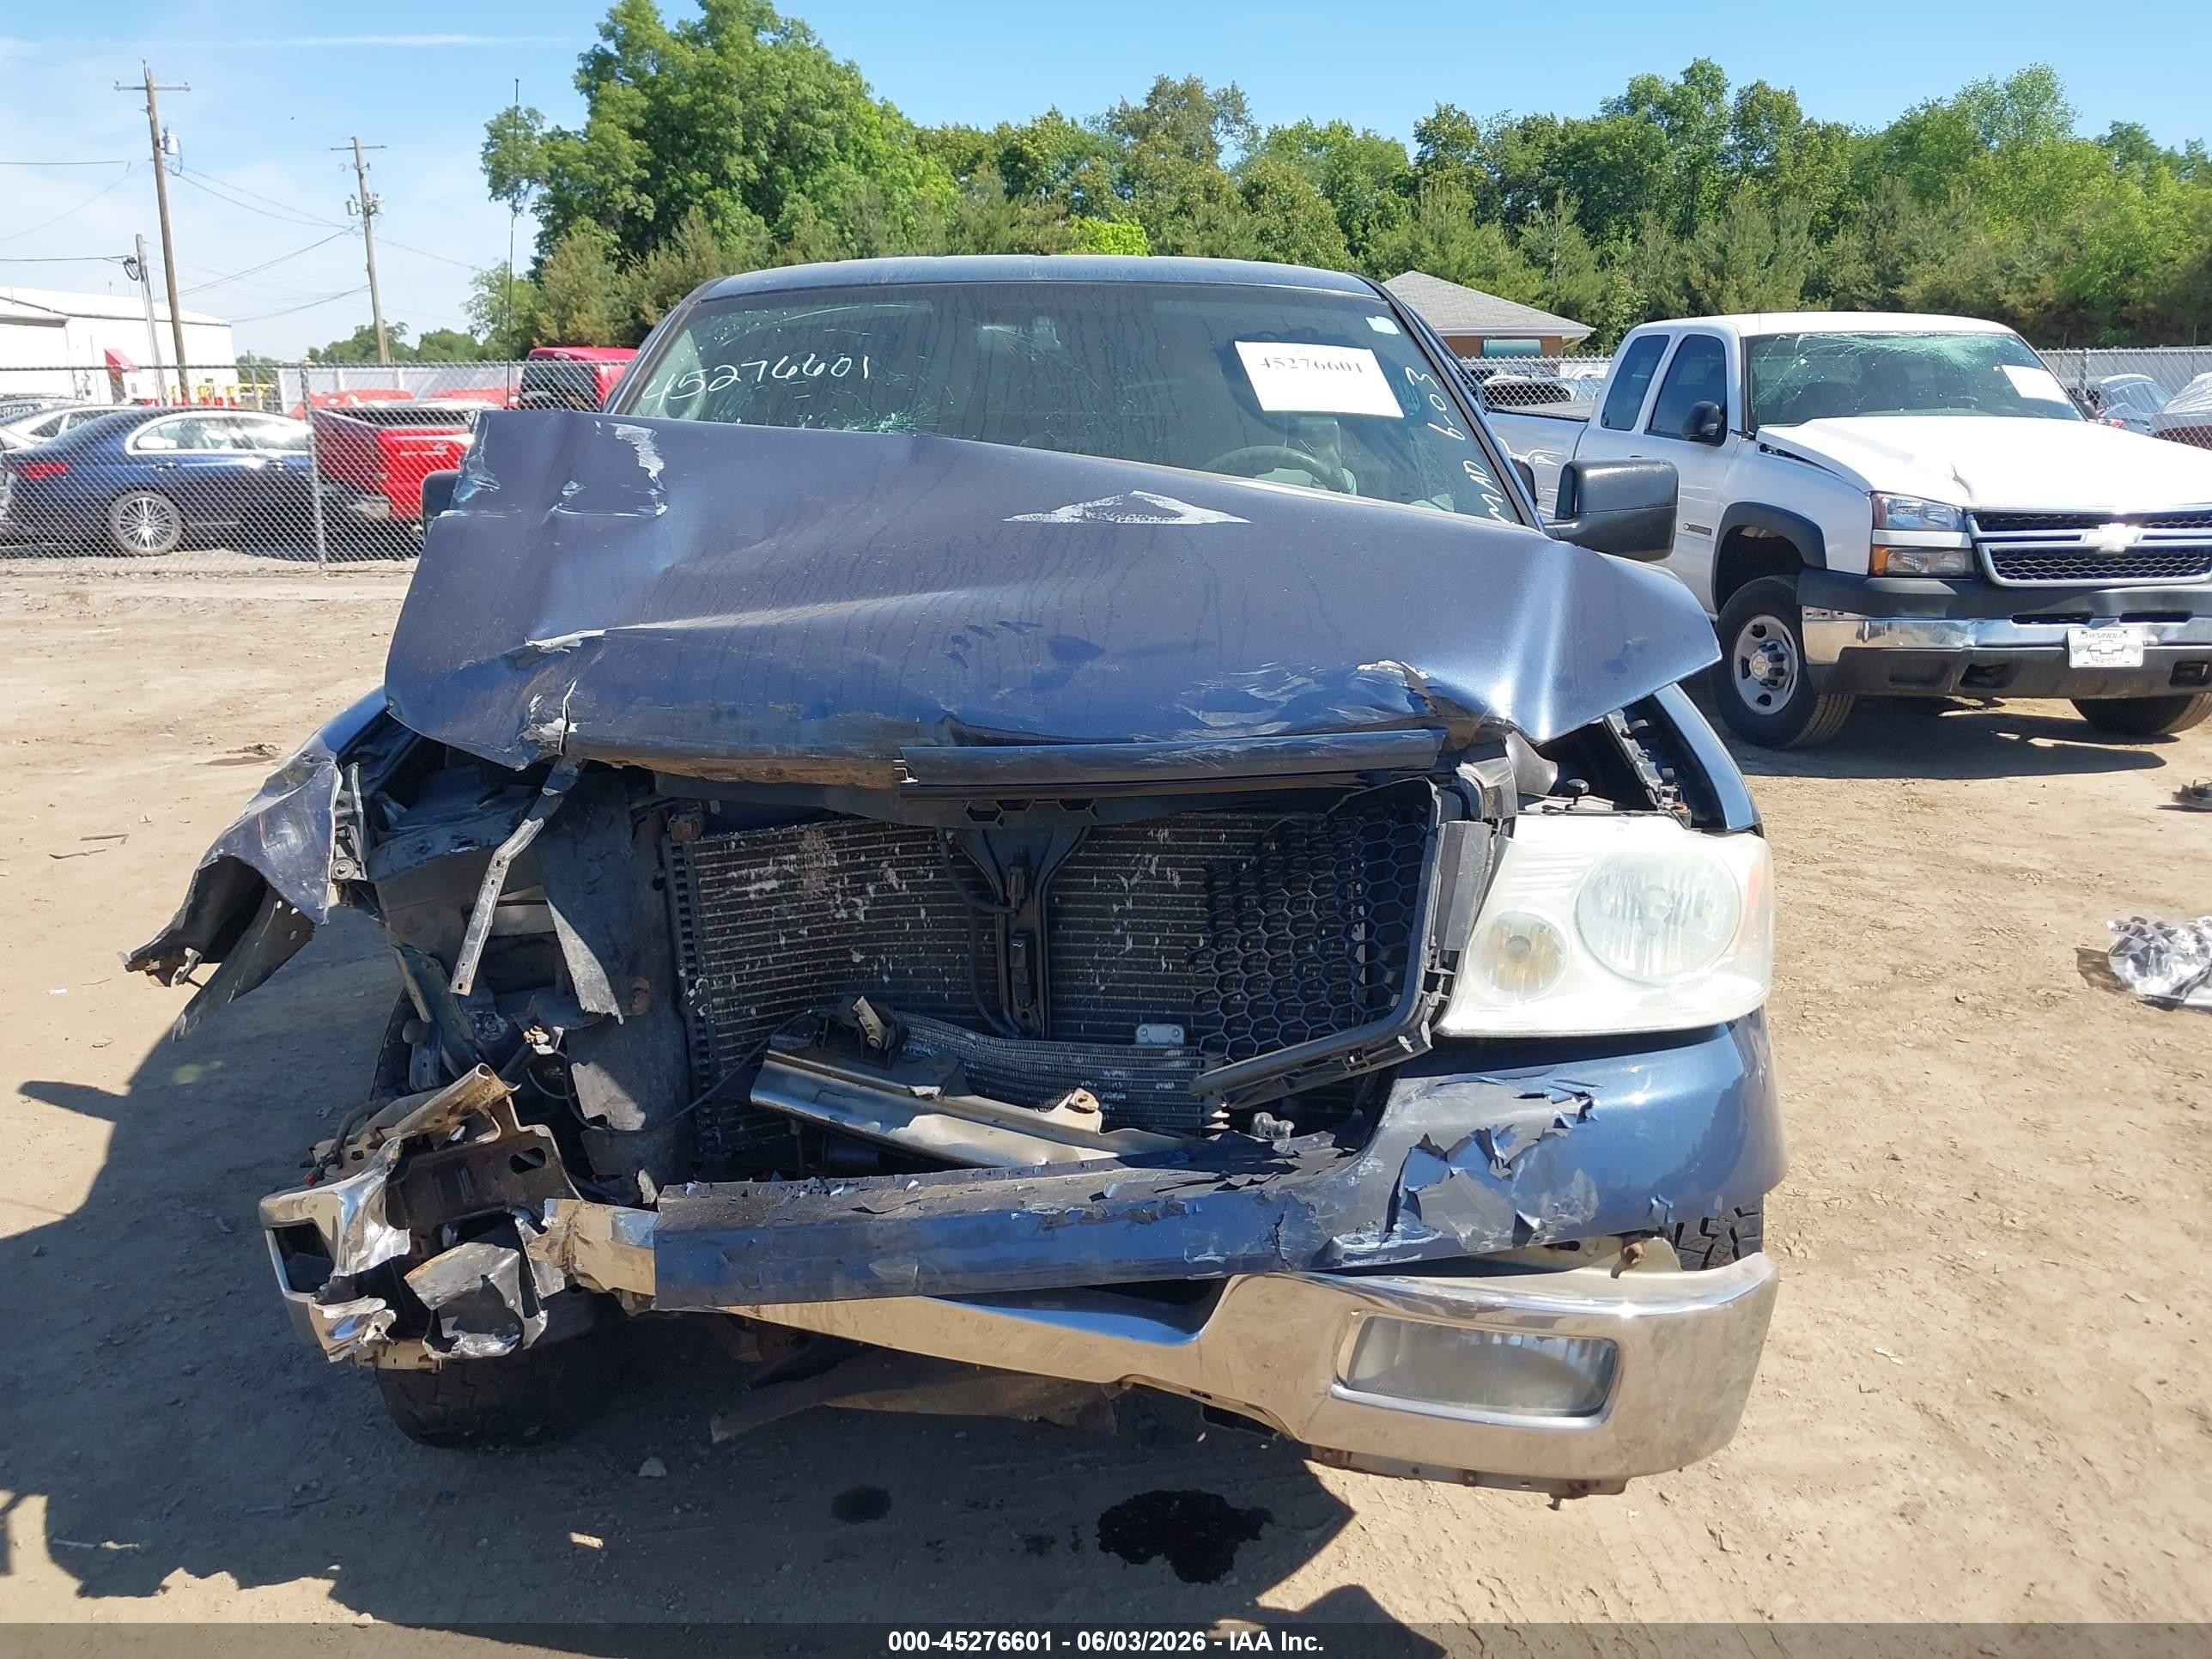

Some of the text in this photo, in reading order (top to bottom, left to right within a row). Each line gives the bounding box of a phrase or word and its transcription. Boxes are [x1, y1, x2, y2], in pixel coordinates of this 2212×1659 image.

[641, 352, 870, 410] 45276601
[1259, 356, 1364, 374] 45276601
[1405, 366, 1466, 441] 6-03
